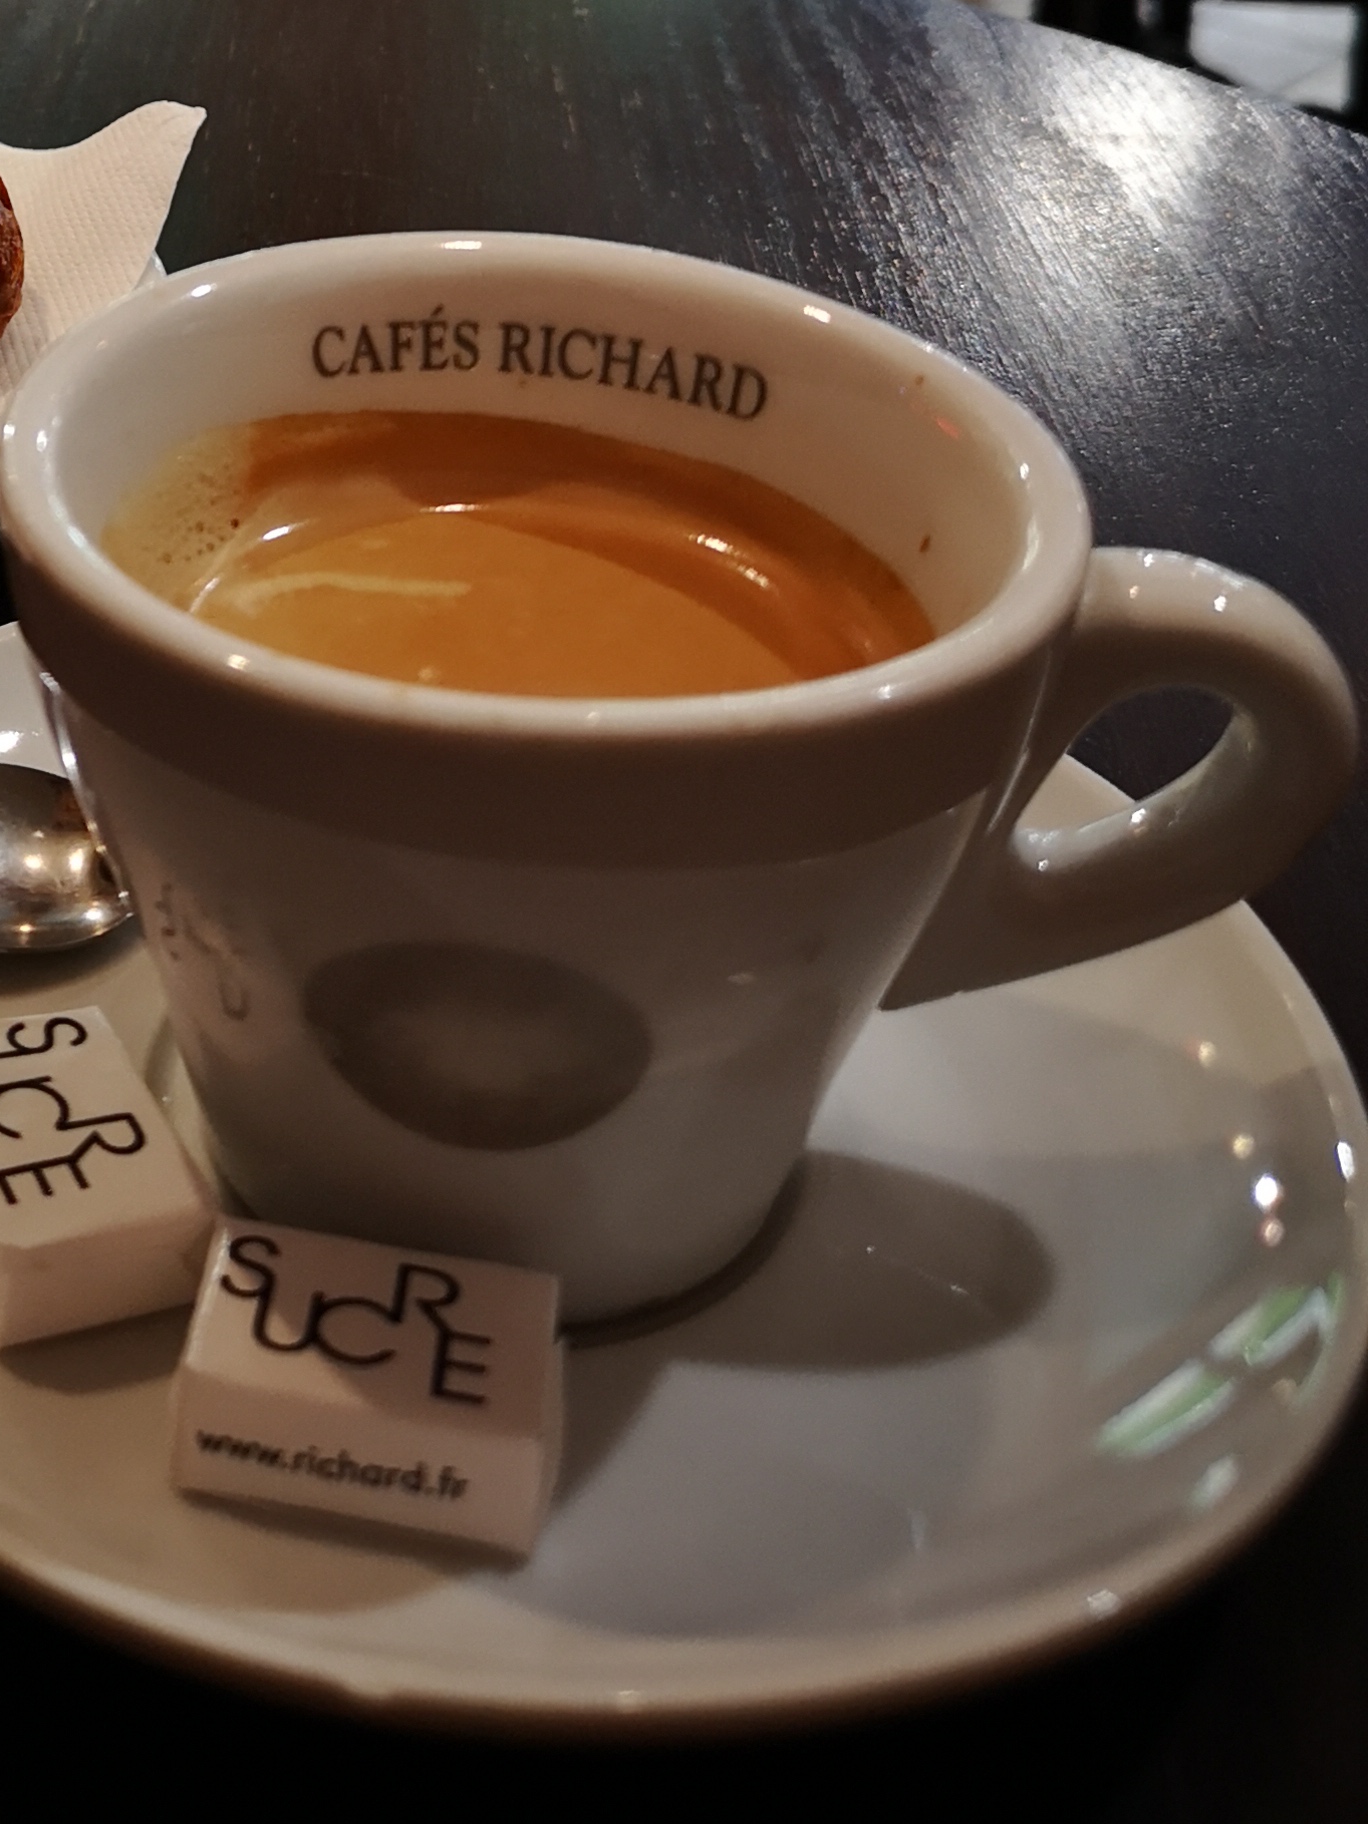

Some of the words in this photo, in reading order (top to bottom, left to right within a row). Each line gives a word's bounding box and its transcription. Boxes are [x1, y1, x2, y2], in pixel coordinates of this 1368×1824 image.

[311, 303, 481, 378] CAFÉS
[497, 321, 769, 421] RICHARD
[220, 1234, 492, 1405] SUCRE
[196, 1428, 469, 1500] www.richard.fr
